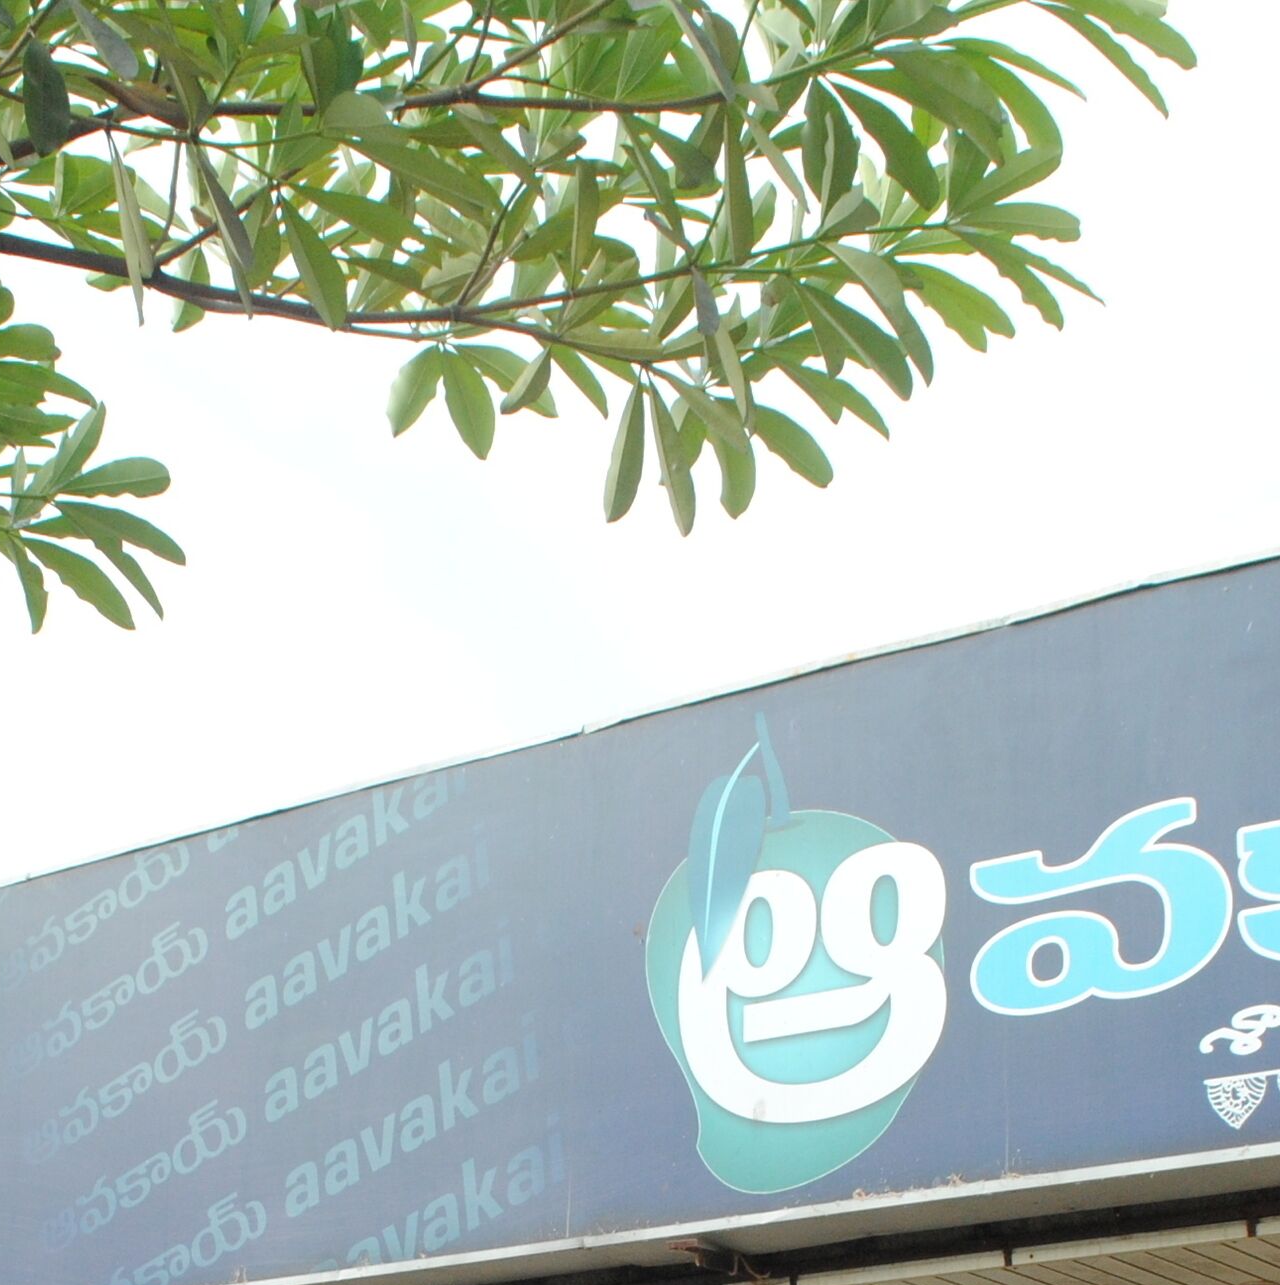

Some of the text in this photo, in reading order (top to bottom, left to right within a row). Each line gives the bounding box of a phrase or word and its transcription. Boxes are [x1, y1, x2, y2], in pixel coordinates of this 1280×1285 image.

[243, 821, 490, 1030] aavakai
[263, 912, 515, 1123] aavakai
[283, 1008, 541, 1218] aavakai
[313, 1107, 566, 1272] avakai
